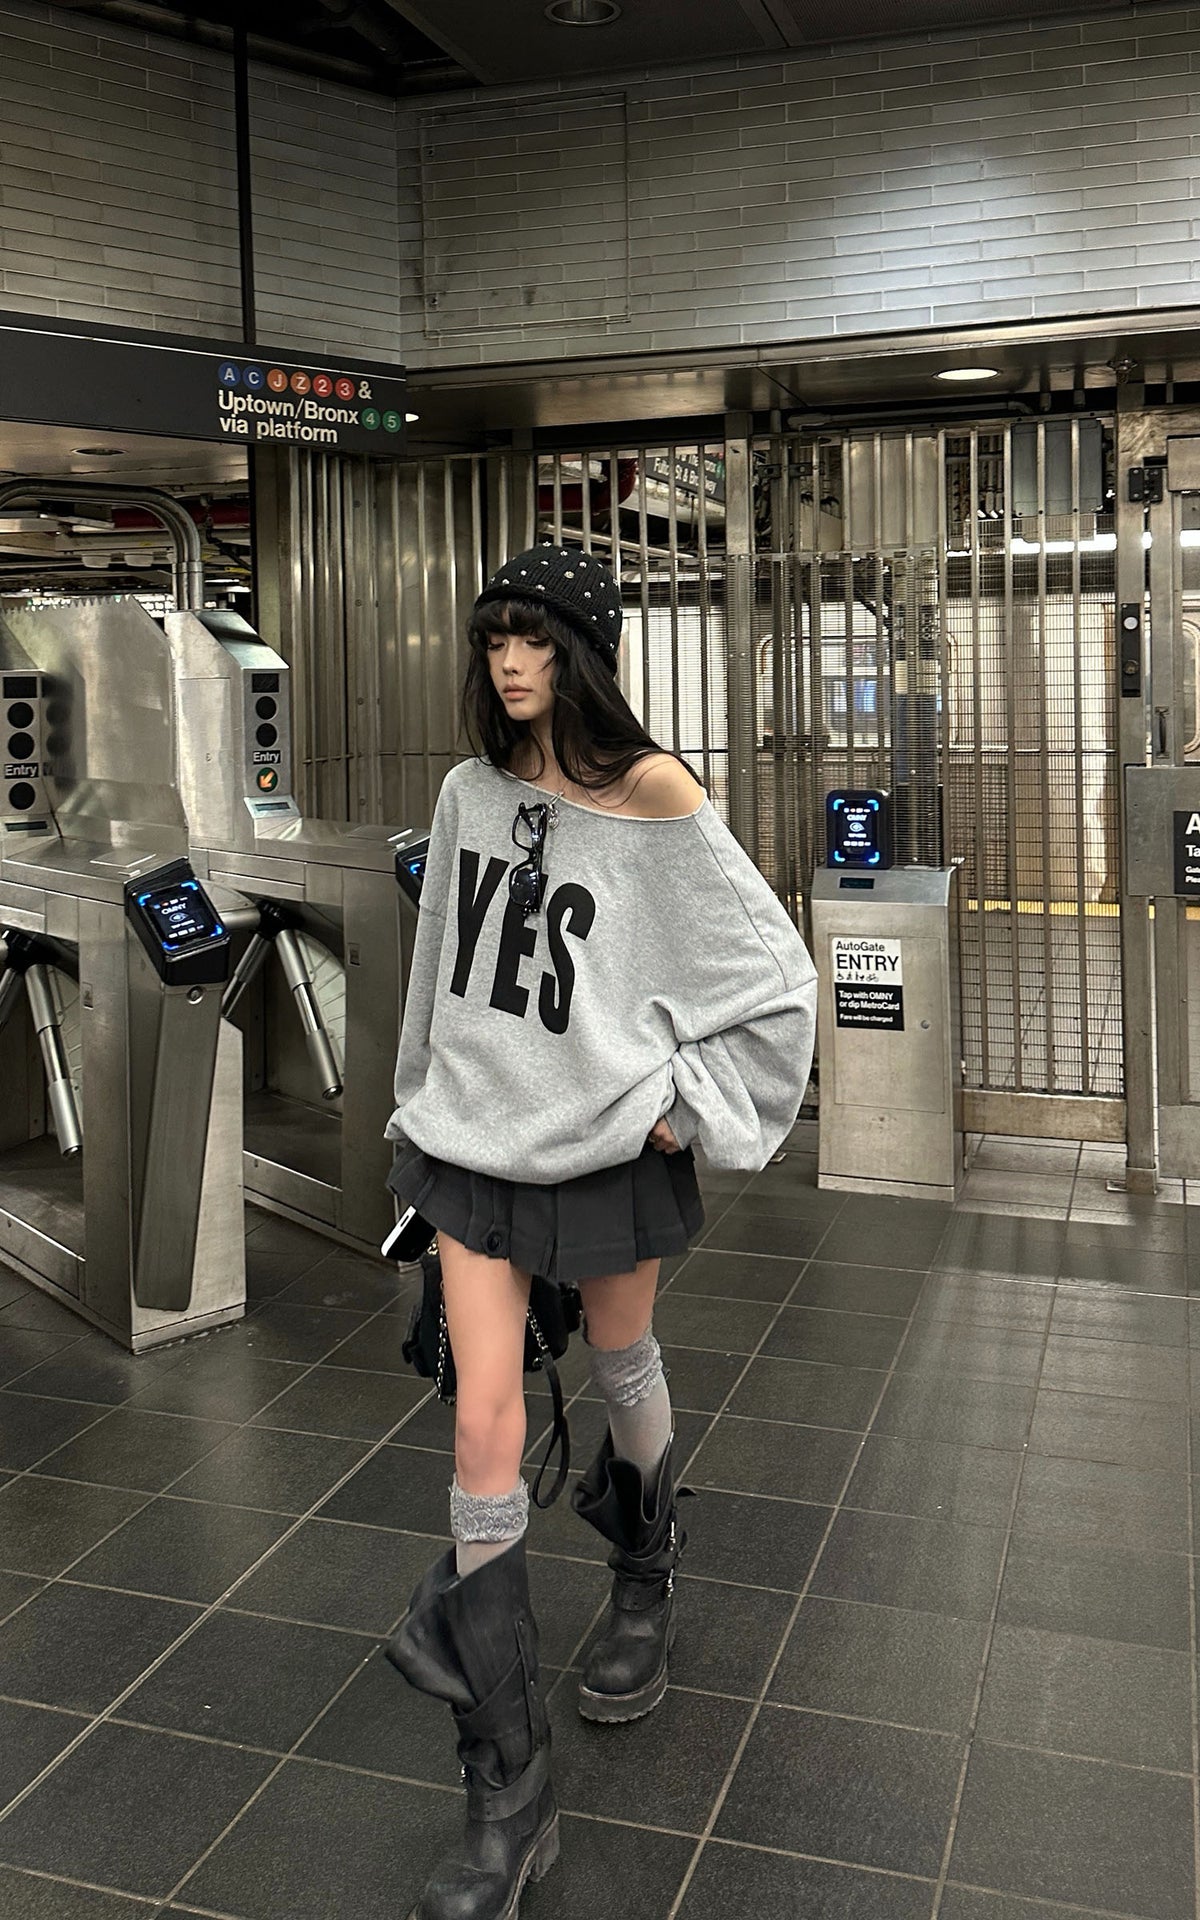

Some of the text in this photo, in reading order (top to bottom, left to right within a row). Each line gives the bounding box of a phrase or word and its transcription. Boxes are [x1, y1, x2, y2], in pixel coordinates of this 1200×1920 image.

[224, 368, 372, 399] A C J Z 2 3 &
[218, 390, 396, 428] Uptown/Bronx 4 5
[220, 414, 338, 443] via platform
[253, 752, 280, 764] Entry
[5, 764, 38, 778] Entry
[450, 848, 596, 1035] YES
[836, 941, 885, 951] AutoGate
[836, 954, 899, 971] ENTRY
[839, 990, 893, 1000] Tap with OMNY
[848, 1001, 860, 1009] dip
[860, 1001, 900, 1010] MetroCard
